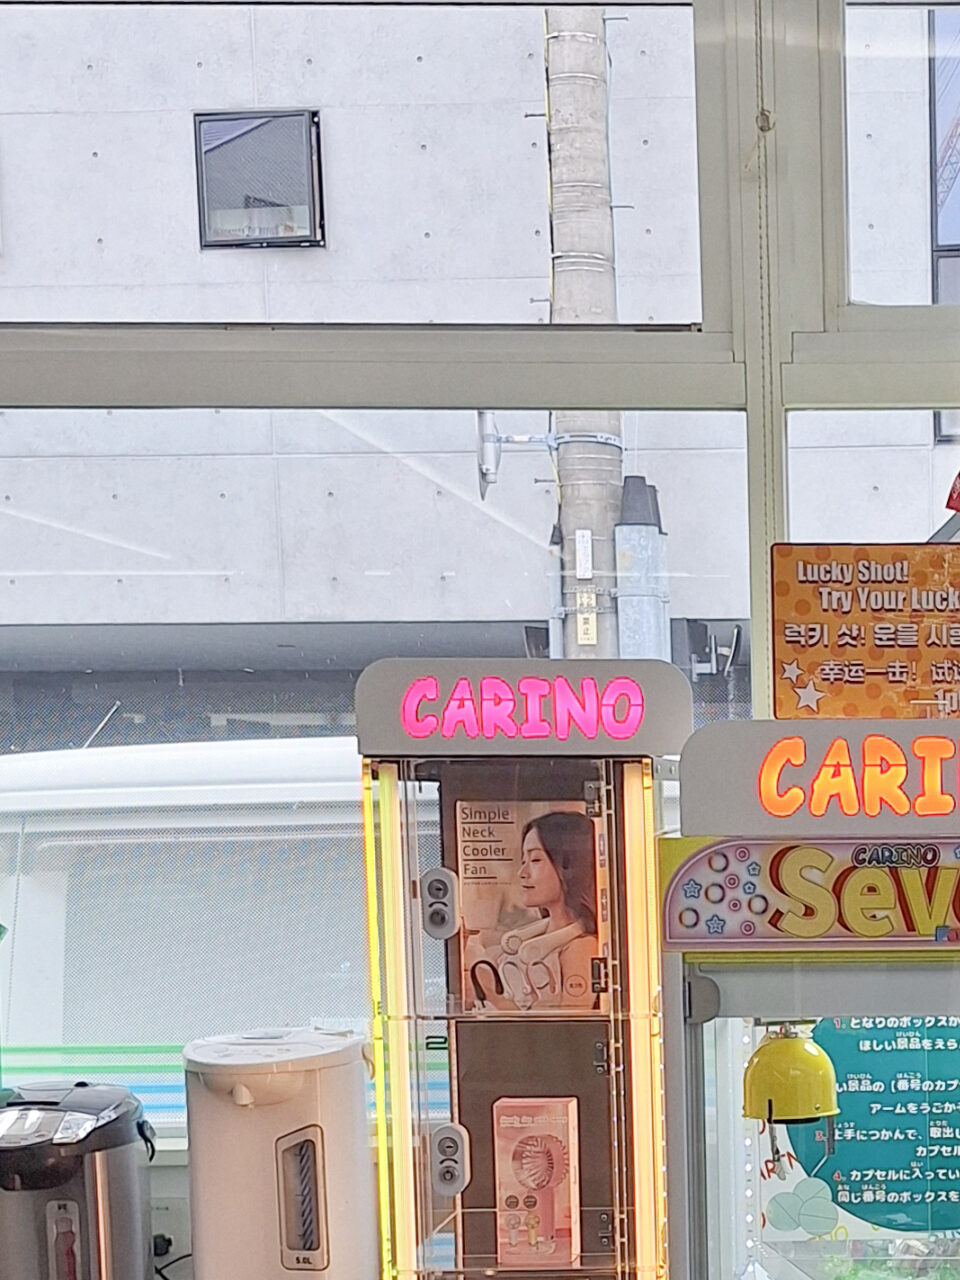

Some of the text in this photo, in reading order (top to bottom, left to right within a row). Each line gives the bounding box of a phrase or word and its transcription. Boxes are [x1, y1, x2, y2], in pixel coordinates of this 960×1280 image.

[797, 560, 909, 584] Lucky Shot!
[819, 586, 853, 612] Try
[857, 587, 905, 611] Your
[784, 623, 829, 647] 럭키
[837, 623, 865, 647] 샷!
[873, 623, 919, 647] 운을
[401, 675, 644, 741] CARINO
[461, 807, 510, 822] Simple
[462, 827, 496, 838] Neck
[462, 845, 507, 857] Cooler
[853, 845, 939, 867] CARINO
[463, 864, 487, 875] Fan
[425, 1036, 448, 1050] 2
